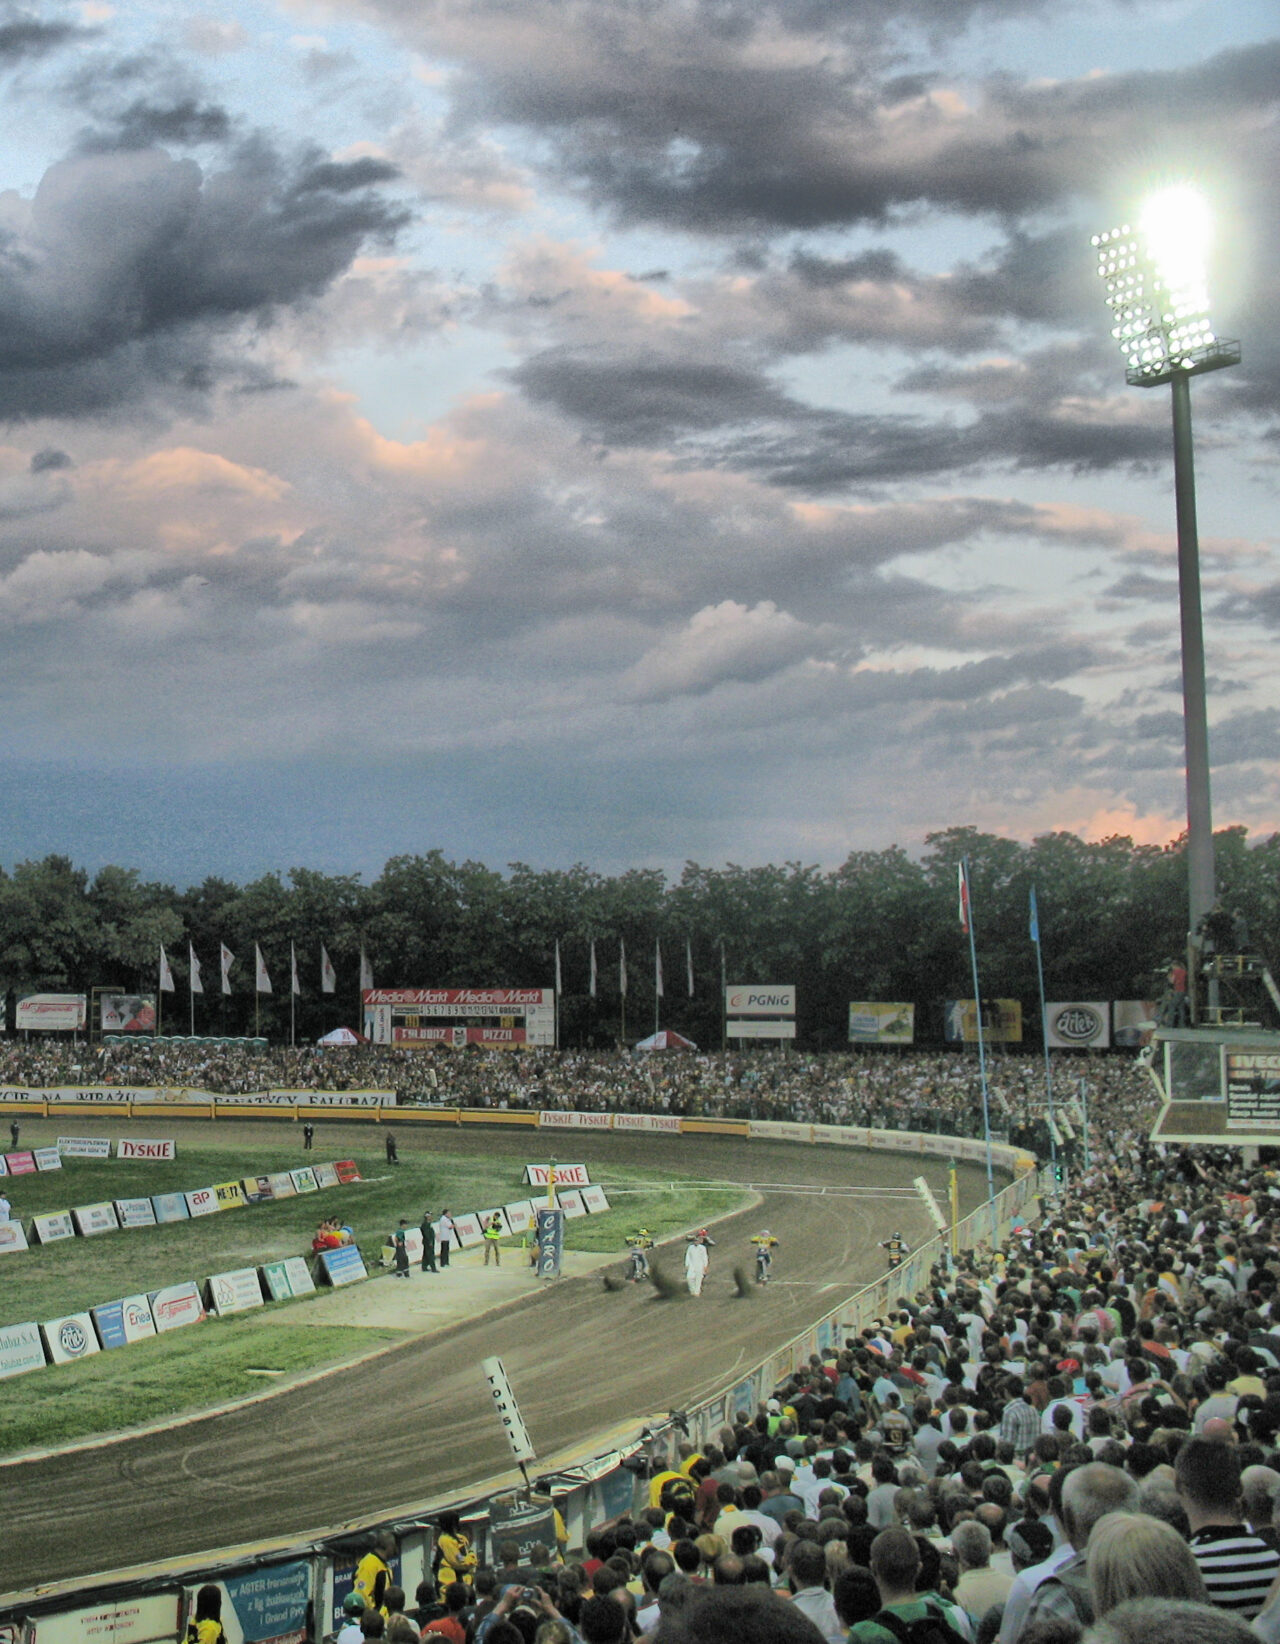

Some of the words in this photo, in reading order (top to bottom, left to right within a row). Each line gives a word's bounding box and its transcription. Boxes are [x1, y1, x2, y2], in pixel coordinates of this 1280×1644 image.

[365, 989, 405, 1003] Media
[412, 989, 449, 1003] Markt
[453, 989, 494, 1003] Media
[503, 989, 540, 1003] Markt
[747, 994, 790, 1006] PGNiG
[542, 1112, 573, 1124] TYSKIE
[578, 1113, 609, 1125] TYSKIE
[617, 1115, 645, 1128] TYSKIE
[650, 1116, 680, 1129] TYSKIE
[122, 1140, 170, 1157] TYSKIE
[531, 1166, 585, 1184] TYSKIE
[543, 1215, 556, 1273] CARO
[129, 1311, 151, 1326] Enea
[21, 1331, 38, 1346] S.A.
[487, 1375, 521, 1453] TONSIL
[265, 1608, 288, 1625] Grand
